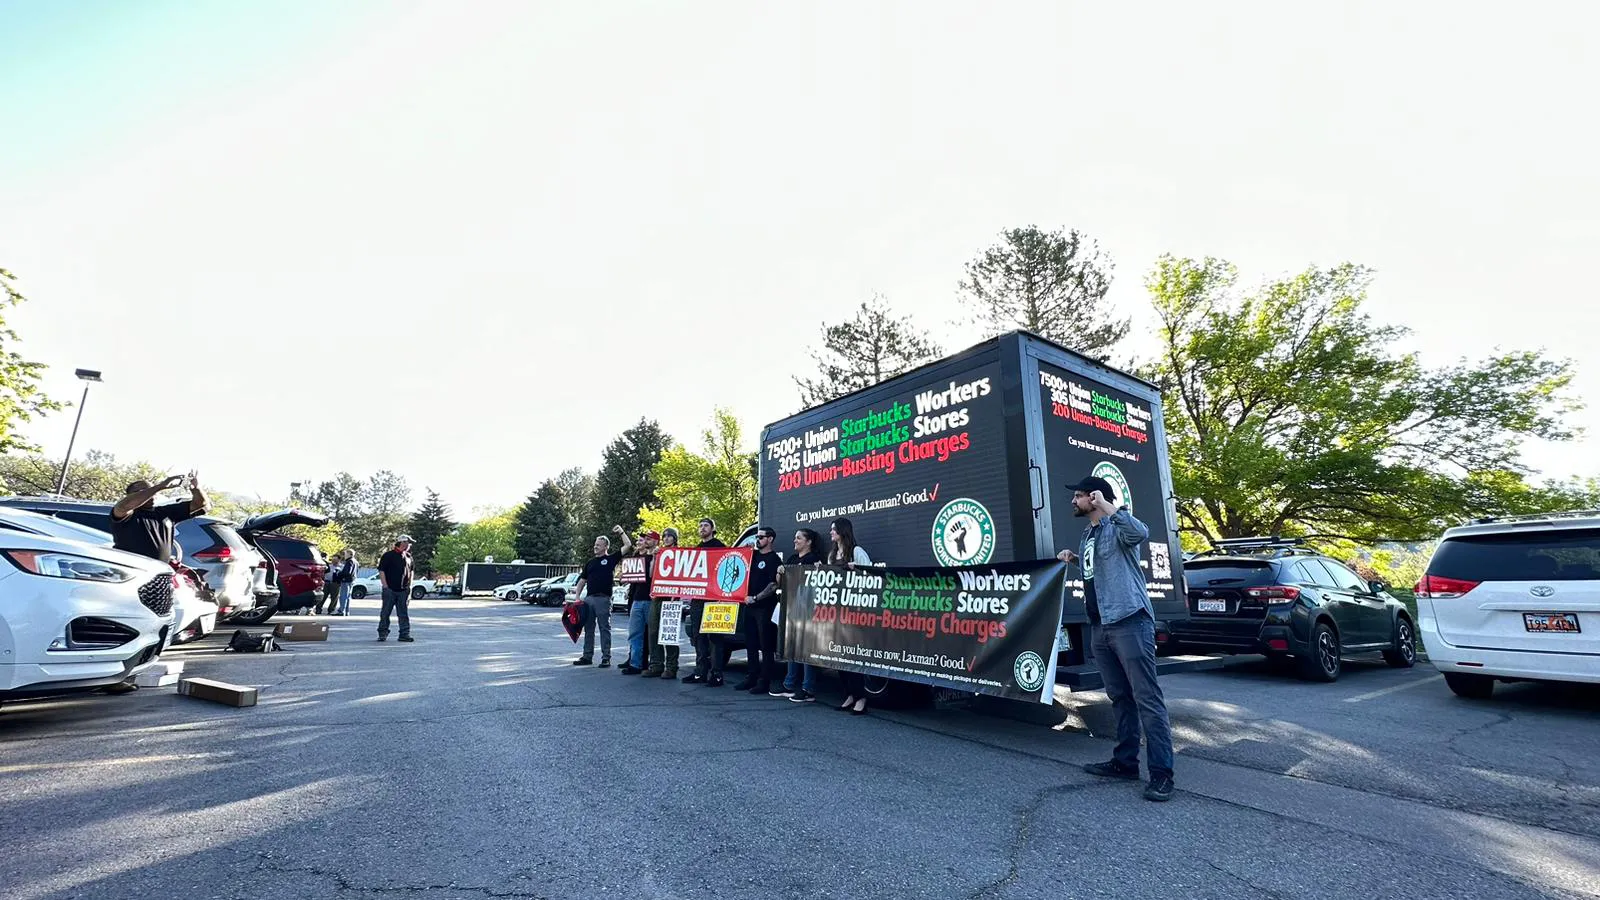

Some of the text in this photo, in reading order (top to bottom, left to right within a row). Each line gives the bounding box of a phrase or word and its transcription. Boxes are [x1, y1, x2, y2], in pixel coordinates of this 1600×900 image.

[1039, 371, 1152, 422] 7500+ Union Starbucks Workers
[1050, 388, 1147, 431] 305 Union Starbucks Stores
[767, 377, 991, 460] 7500+ Union Starbucks Workers
[1052, 402, 1148, 444] 200 Union-Busting Charges
[777, 408, 970, 475] 305 Union Starbucks Stores
[778, 432, 970, 492] 200 Union-Busting Charges
[796, 488, 929, 523] Can you hear us now, Laxman? Good.
[939, 503, 986, 526] STARBUCKS
[621, 558, 645, 574] CWA
[659, 549, 708, 579] CWA
[652, 585, 706, 596] STRONGER TOGETHER
[804, 569, 1031, 592] 7500+ Union Starbucks Workers
[814, 587, 1009, 614] 305 Union Starbucks Stores
[812, 605, 1007, 643] 200 Union-Busting Charges
[828, 640, 966, 670] Can you hear us now, Laxman? Good.
[914, 669, 930, 677] working
[936, 672, 953, 680] making
[953, 675, 971, 683] pickups
[978, 679, 1002, 687] deliveries.
